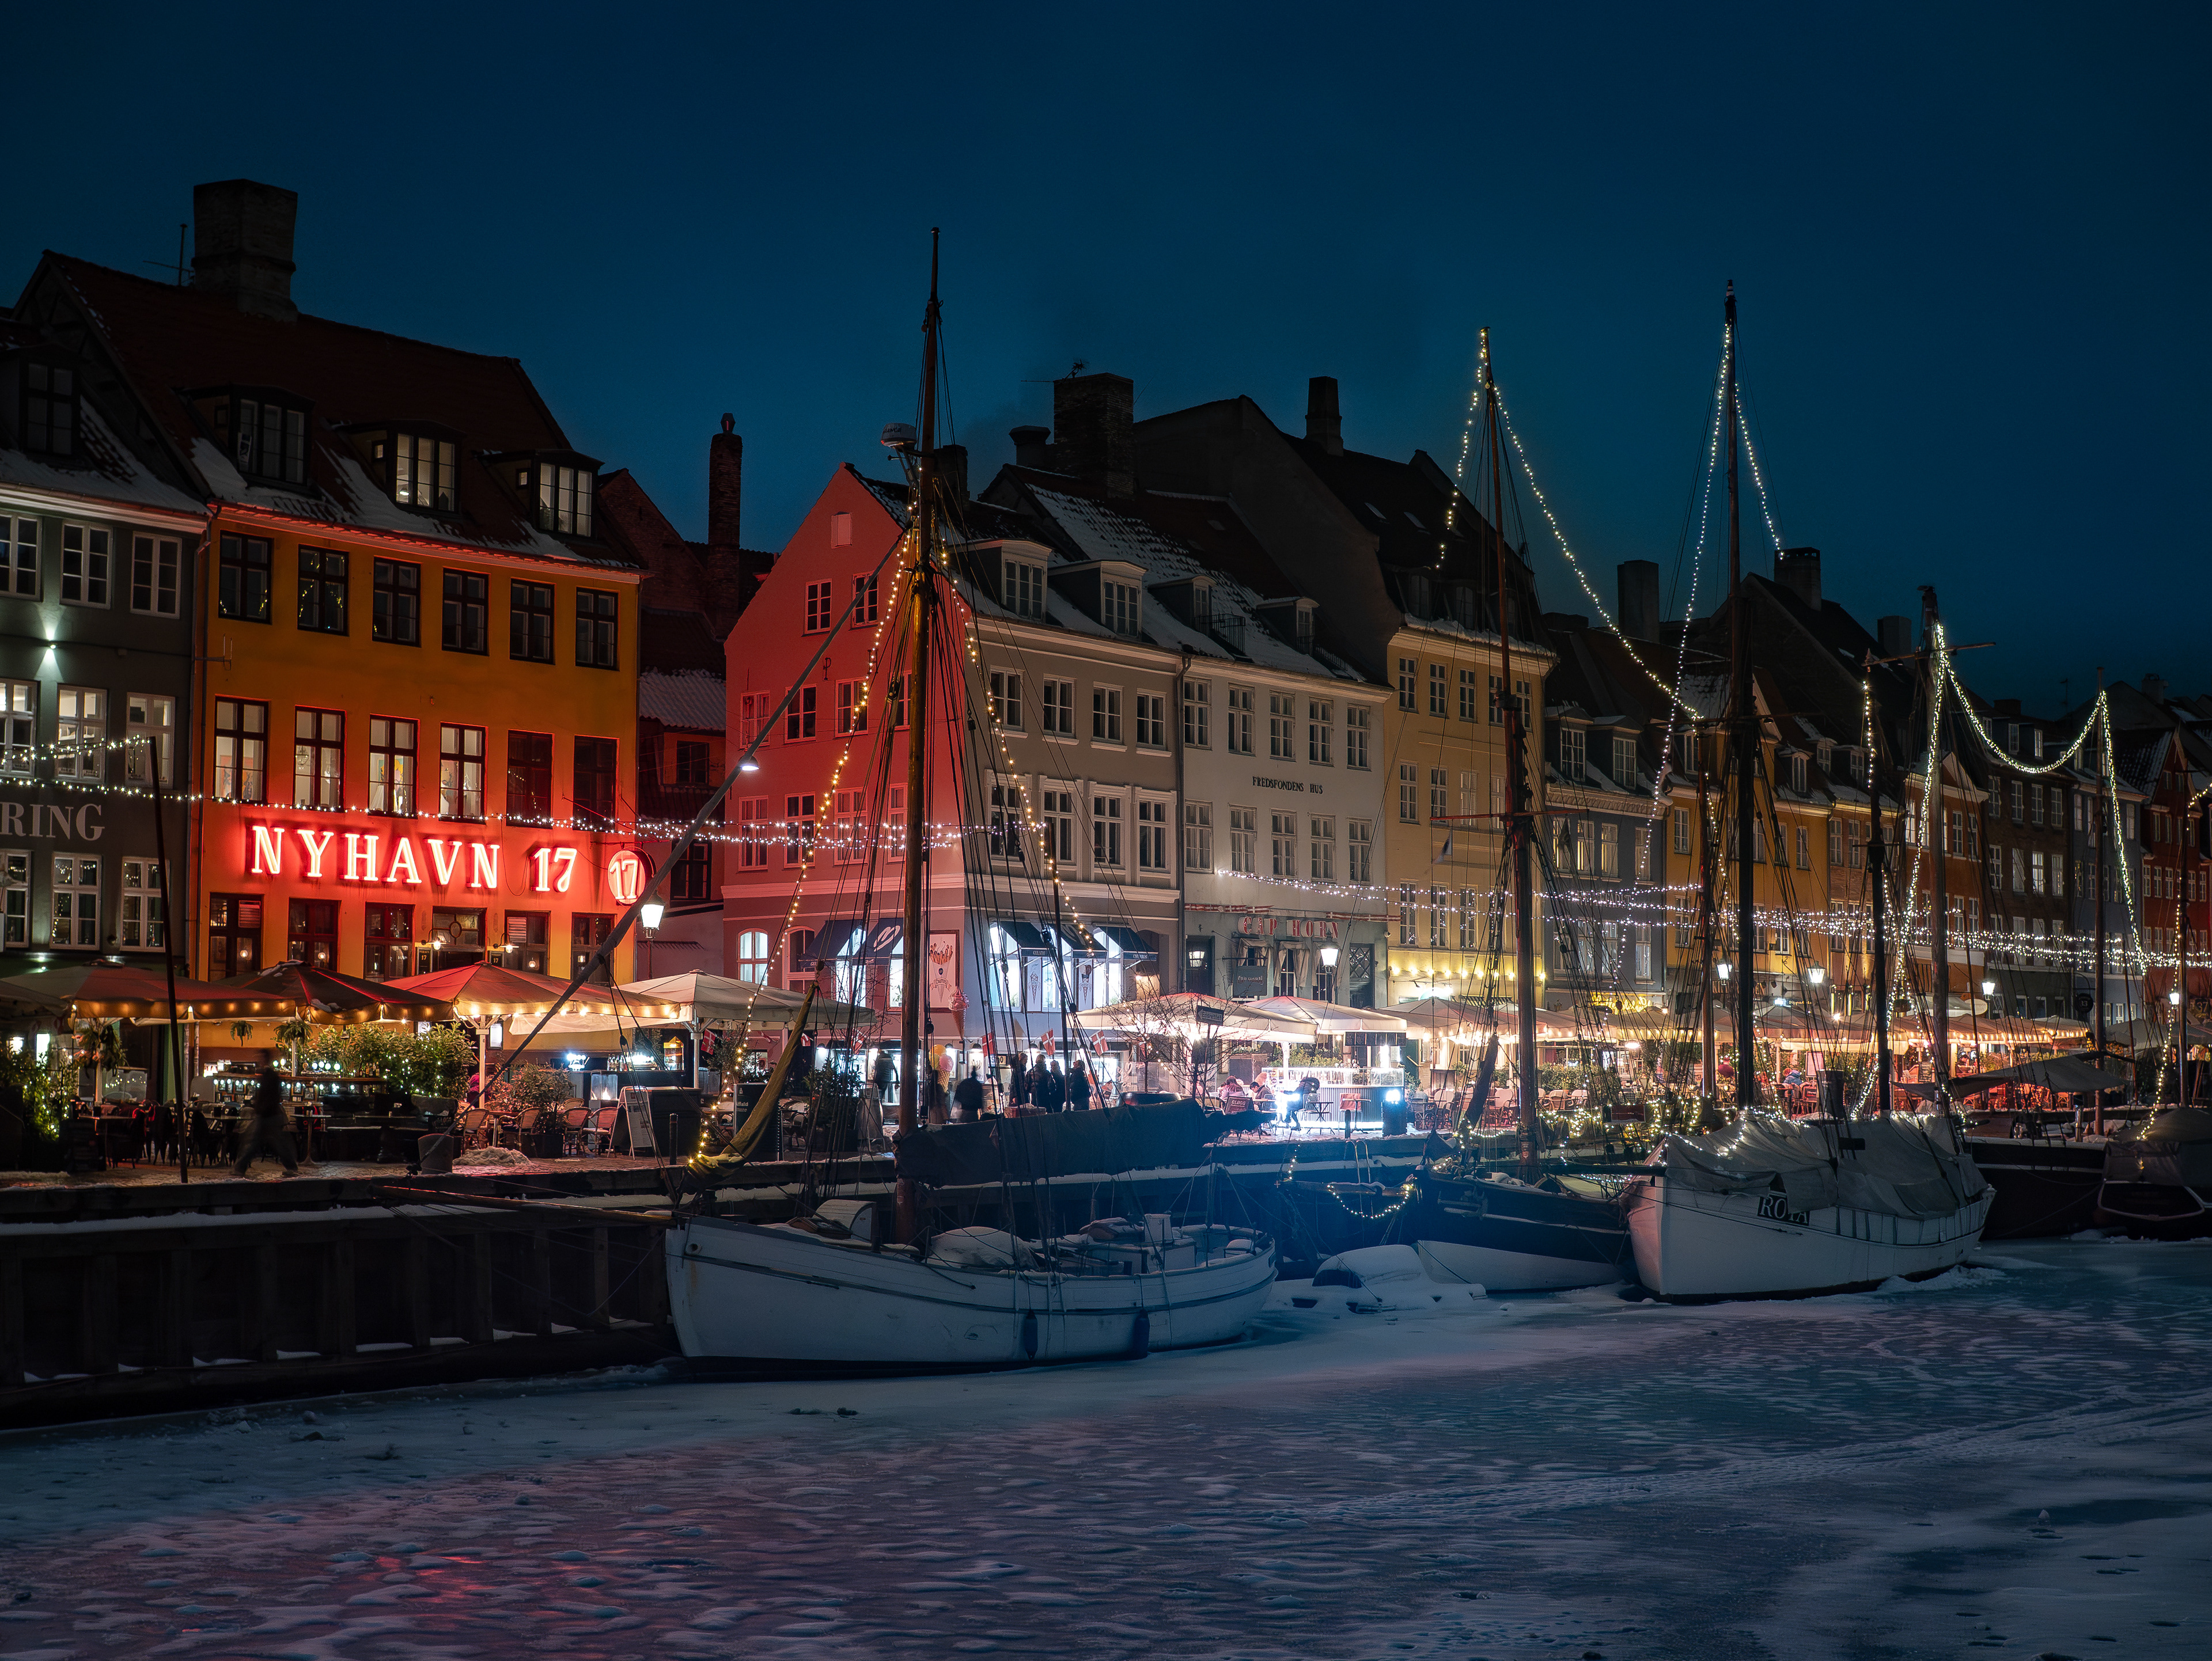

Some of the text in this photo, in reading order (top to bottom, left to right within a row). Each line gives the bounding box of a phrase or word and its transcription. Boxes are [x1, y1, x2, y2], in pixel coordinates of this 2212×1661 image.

[1252, 776, 1323, 794] FREDSFONDENS HUS
[0, 802, 105, 841] RING
[251, 825, 577, 892] NYHAVN 17
[609, 859, 638, 899] 17
[1240, 916, 1339, 938] CAP HORN
